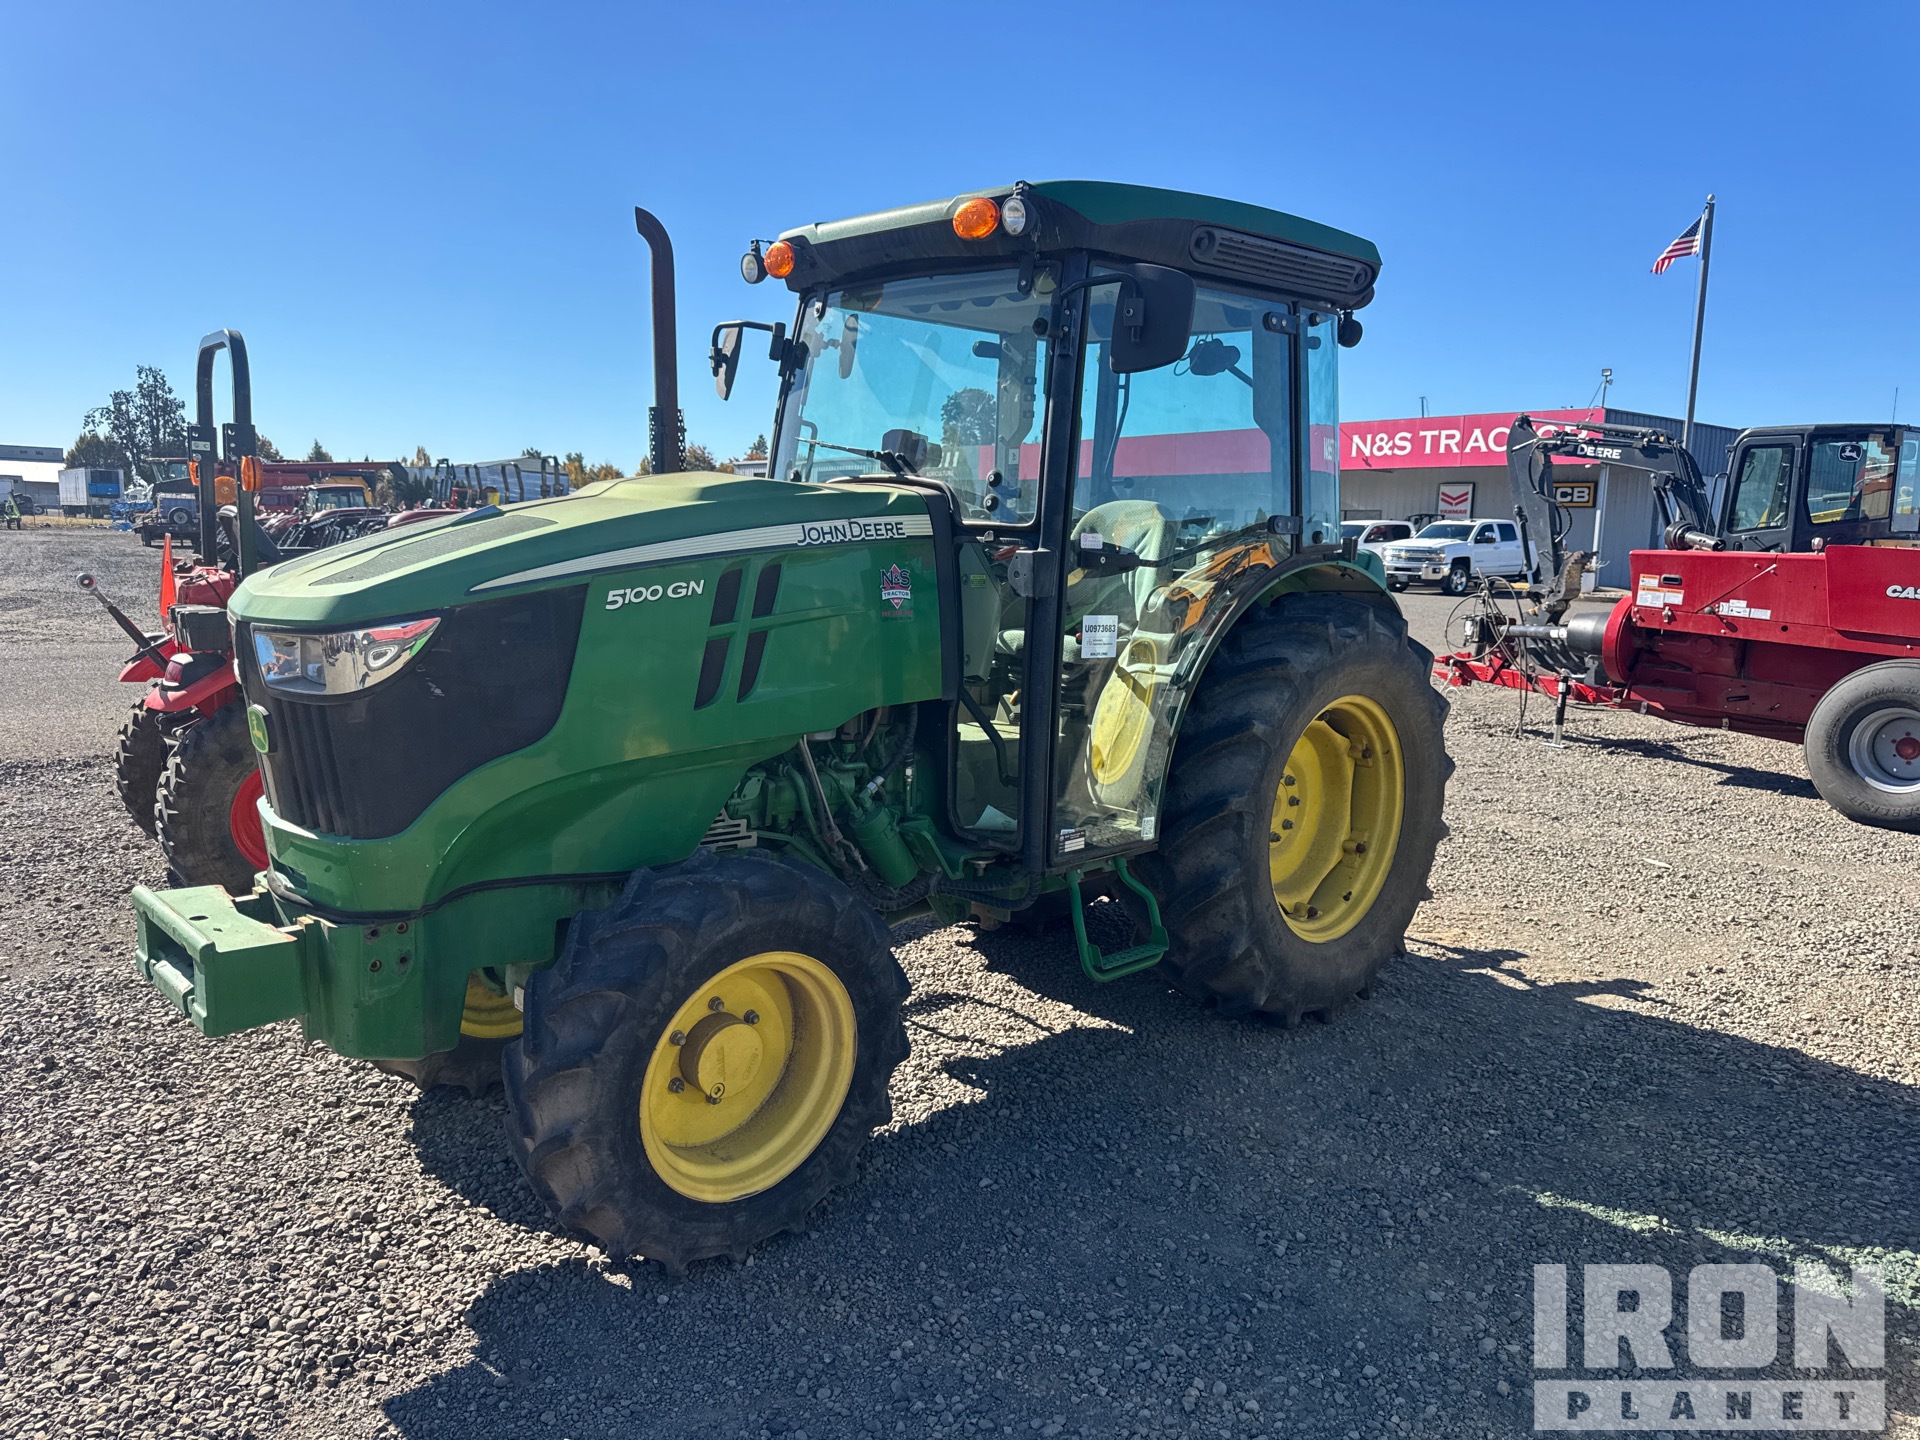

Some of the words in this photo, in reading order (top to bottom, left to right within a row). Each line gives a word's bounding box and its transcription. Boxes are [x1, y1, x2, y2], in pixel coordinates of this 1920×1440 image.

[1351, 432, 1412, 457] N&S
[1419, 424, 1590, 454] TRAC
[1577, 444, 1622, 459] DEERE
[1555, 487, 1590, 502] CB
[797, 523, 847, 545] JOHN
[848, 520, 906, 540] DEERE
[880, 569, 911, 588] N&S
[605, 585, 663, 610] 5100
[667, 580, 704, 598] GN
[883, 590, 910, 598] TRACTOR
[1084, 624, 1116, 633] U0973683
